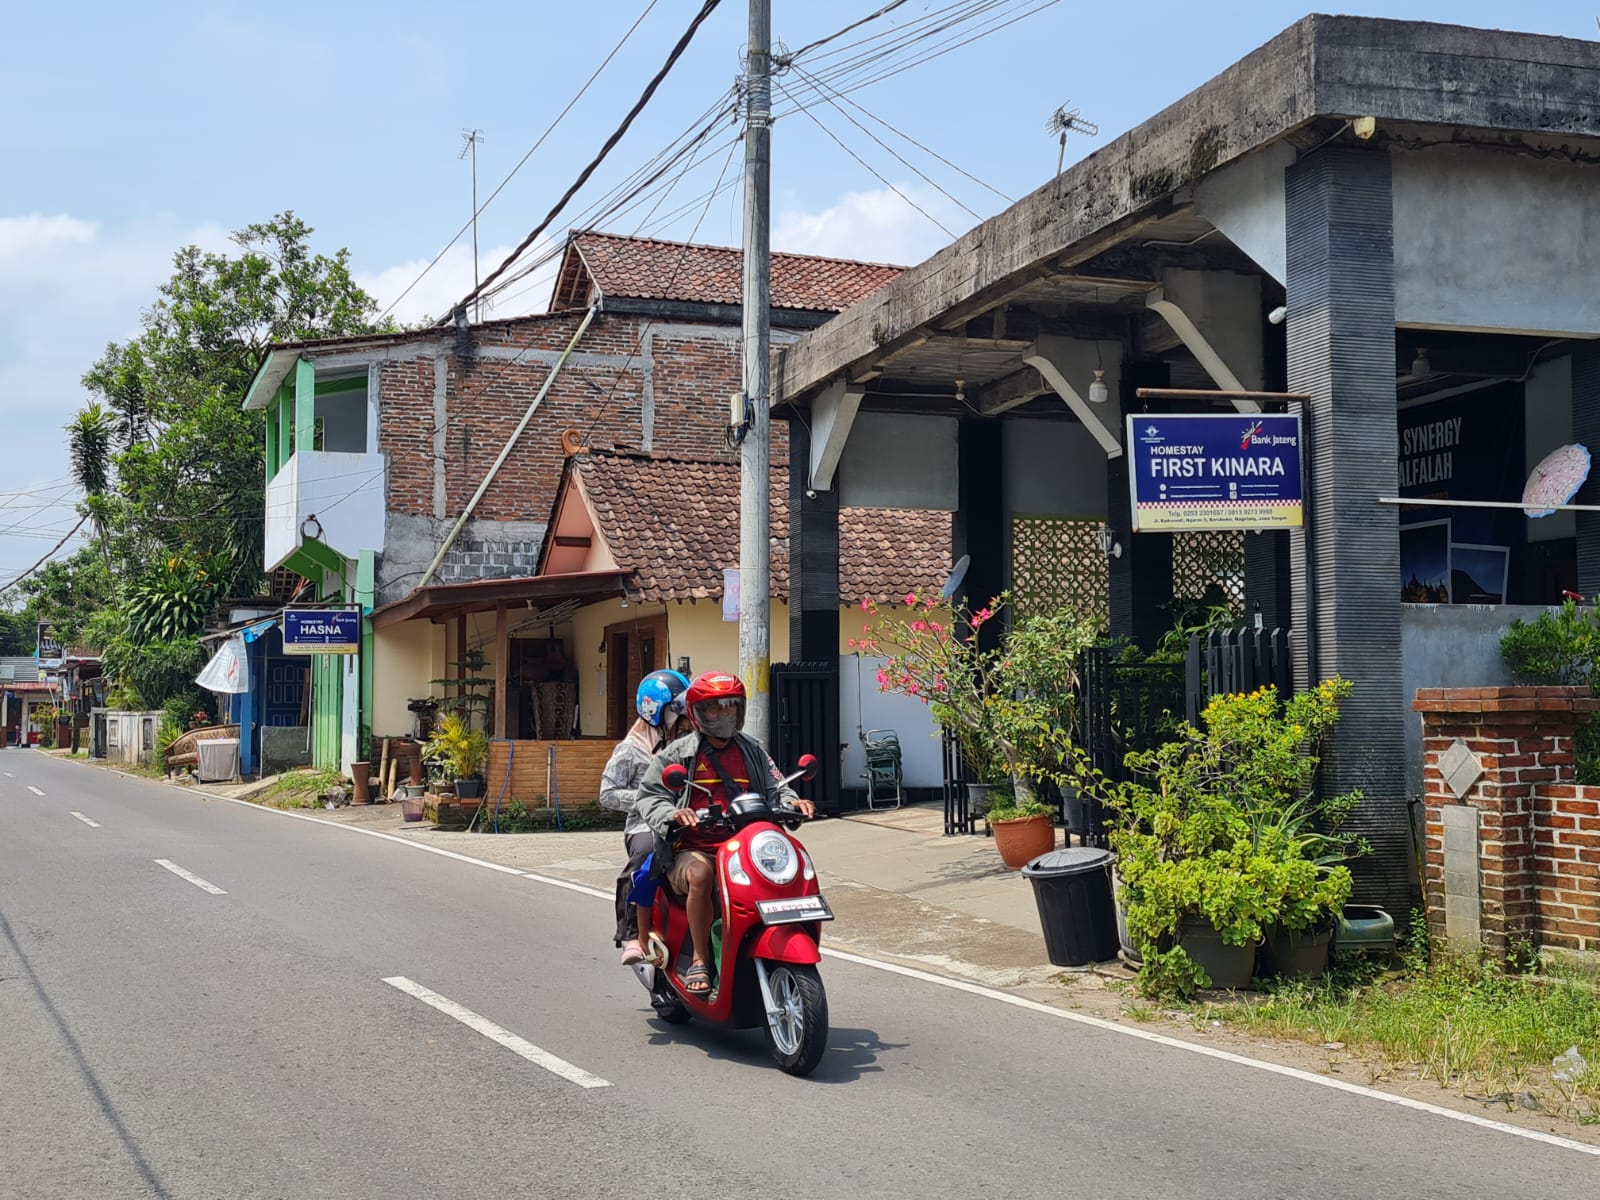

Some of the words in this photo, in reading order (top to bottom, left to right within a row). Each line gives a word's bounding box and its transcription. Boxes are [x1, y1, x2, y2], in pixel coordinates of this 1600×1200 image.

[1252, 435, 1271, 444] Bank
[1272, 435, 1296, 446] Jateng
[1403, 416, 1462, 456] SYNERGY
[1150, 446, 1204, 455] HOMESTAY
[1151, 458, 1206, 478] FIRST
[1211, 457, 1285, 477] KINARA
[1399, 451, 1452, 487] ALFALAH
[300, 625, 342, 634] HASNA
